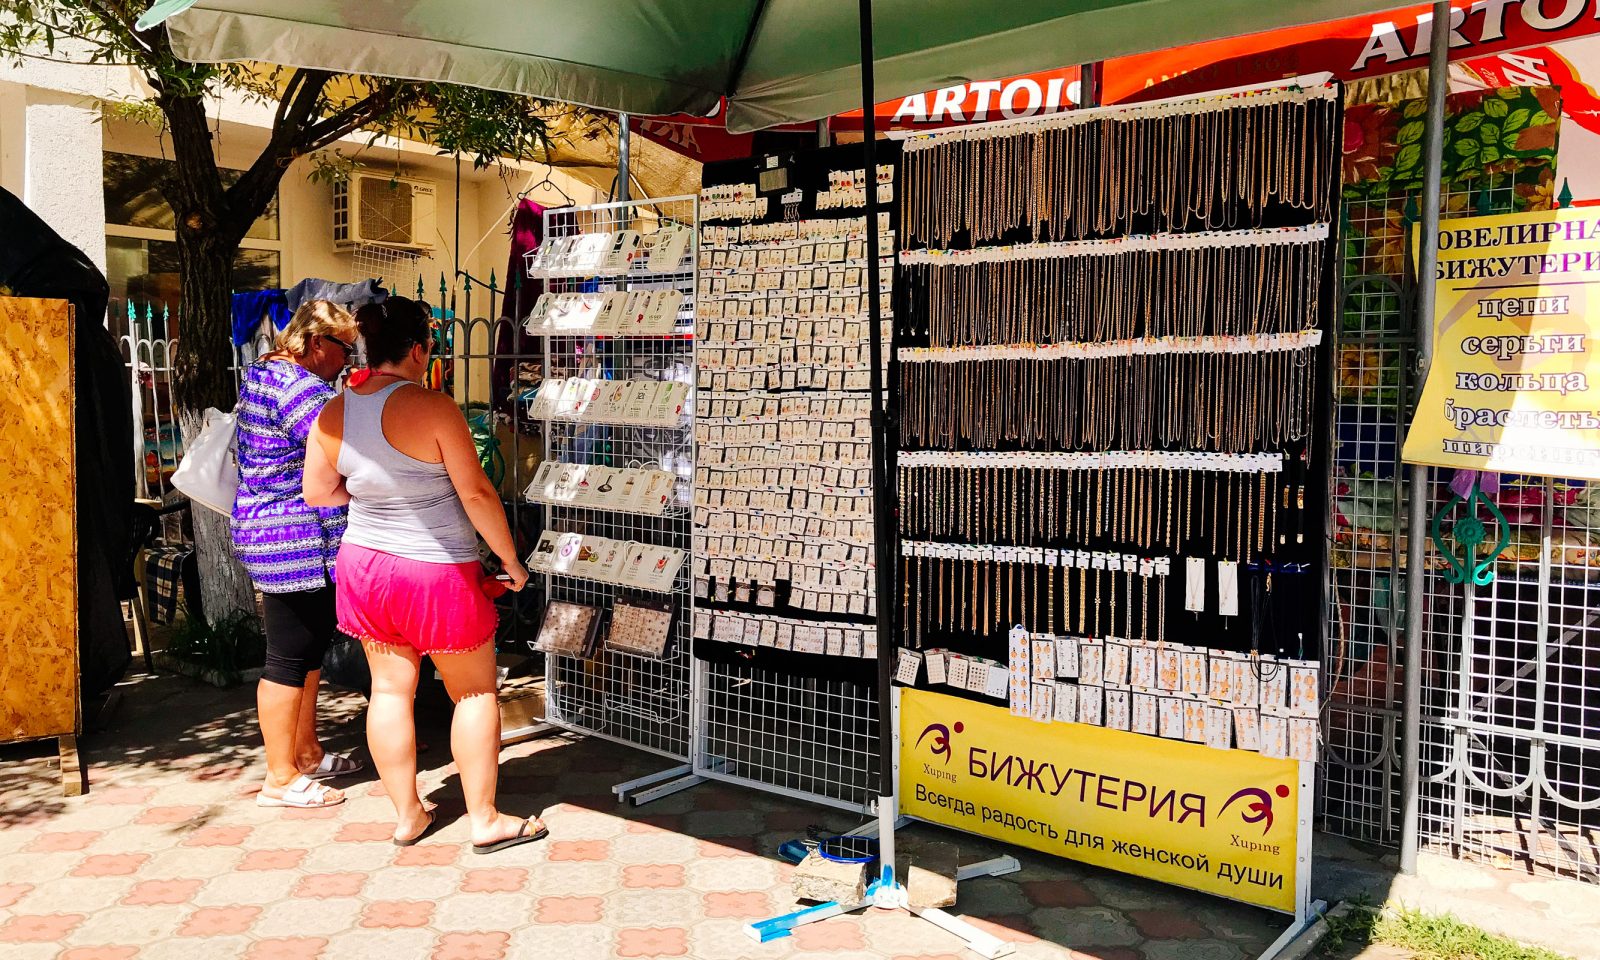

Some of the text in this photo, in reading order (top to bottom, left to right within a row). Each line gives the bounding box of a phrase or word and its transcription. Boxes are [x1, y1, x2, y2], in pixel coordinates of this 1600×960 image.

[1350, 0, 1600, 71] ARTO
[1478, 295, 1569, 321] цепи
[1461, 334, 1585, 360] серьги
[1456, 371, 1589, 395] кольца
[922, 763, 957, 784] Xuping
[967, 746, 1207, 828] БИЖУТЕРИЯ
[915, 784, 1284, 890] Всегда радость для женской души
[1229, 834, 1281, 856] Xuping
